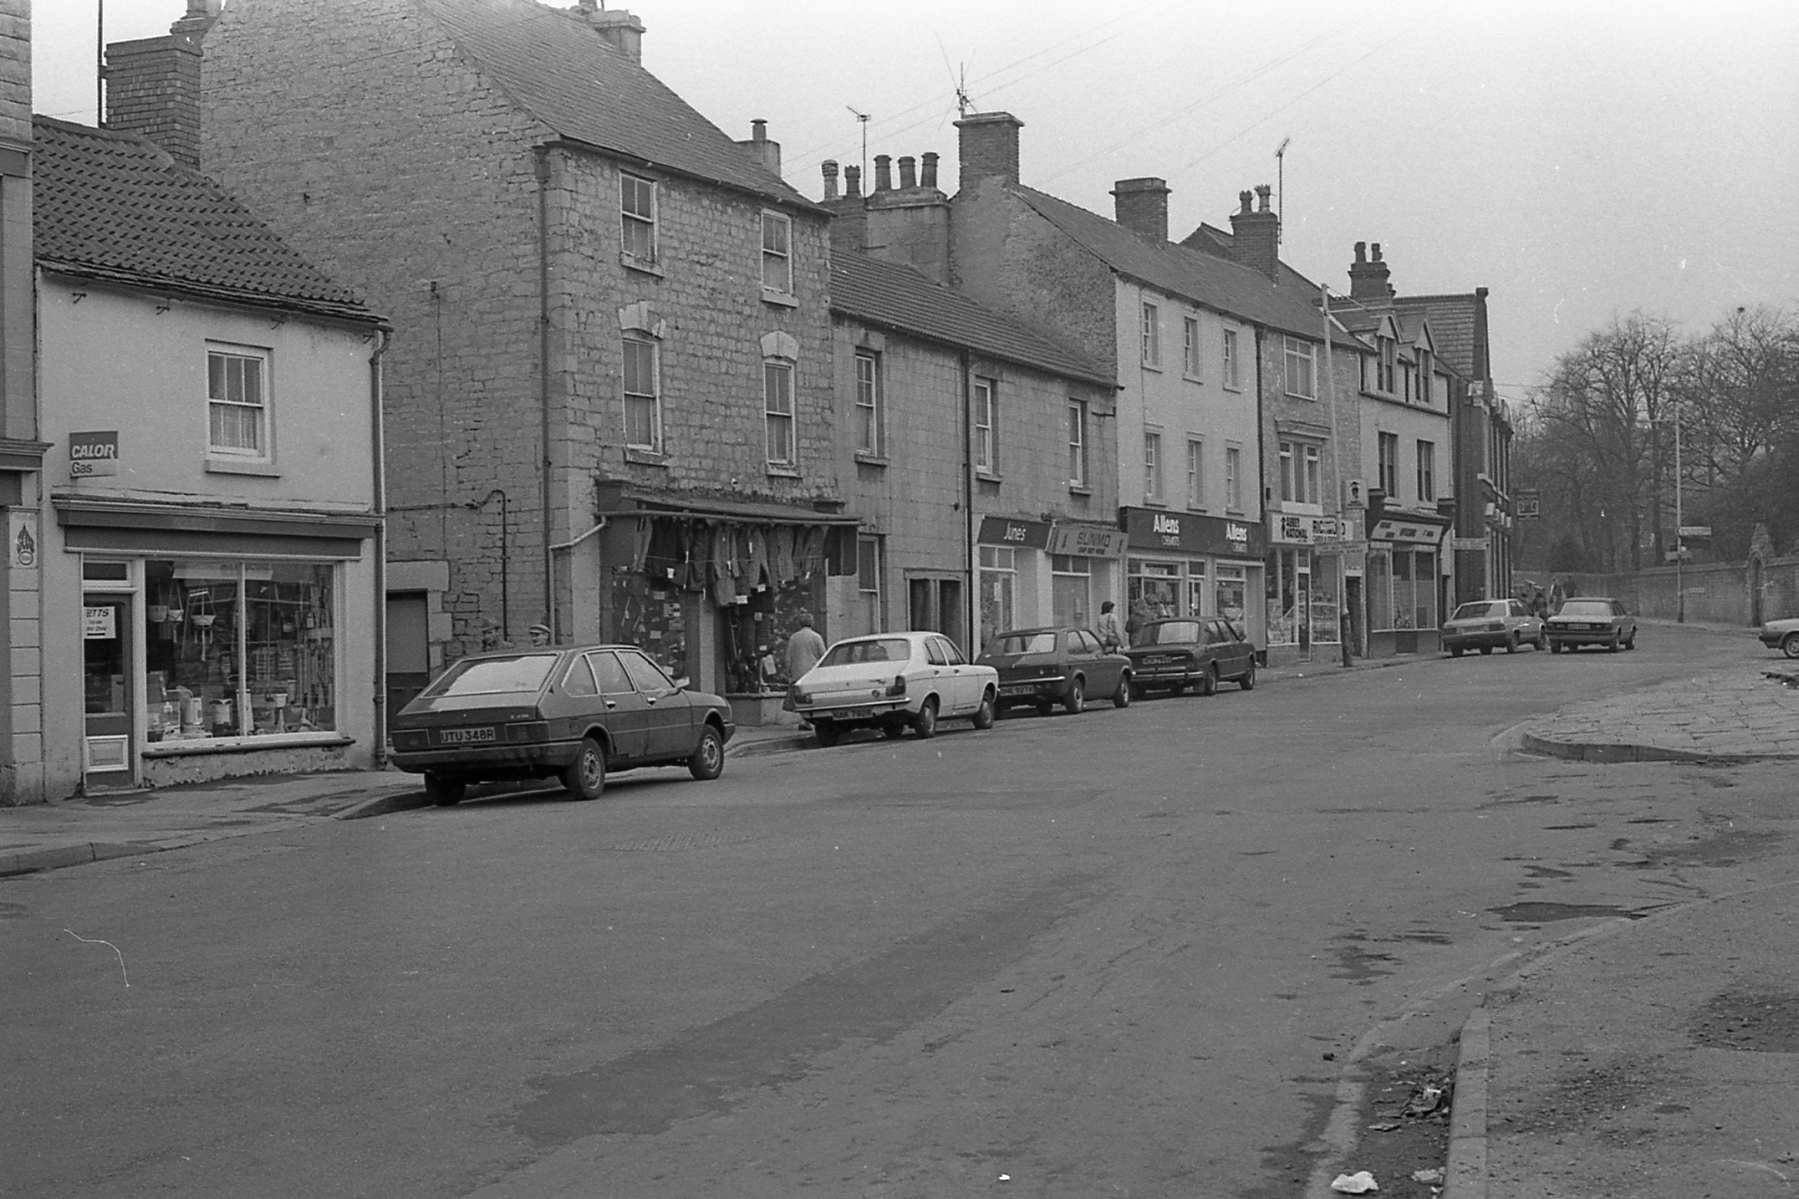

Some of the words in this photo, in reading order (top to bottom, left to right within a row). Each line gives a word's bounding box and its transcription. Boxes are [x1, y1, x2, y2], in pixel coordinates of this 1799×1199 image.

[72, 444, 115, 459] CALOR
[72, 462, 93, 474] Gas
[1153, 514, 1179, 534] Allens
[1226, 522, 1247, 542] Allens
[442, 731, 462, 742] UTU
